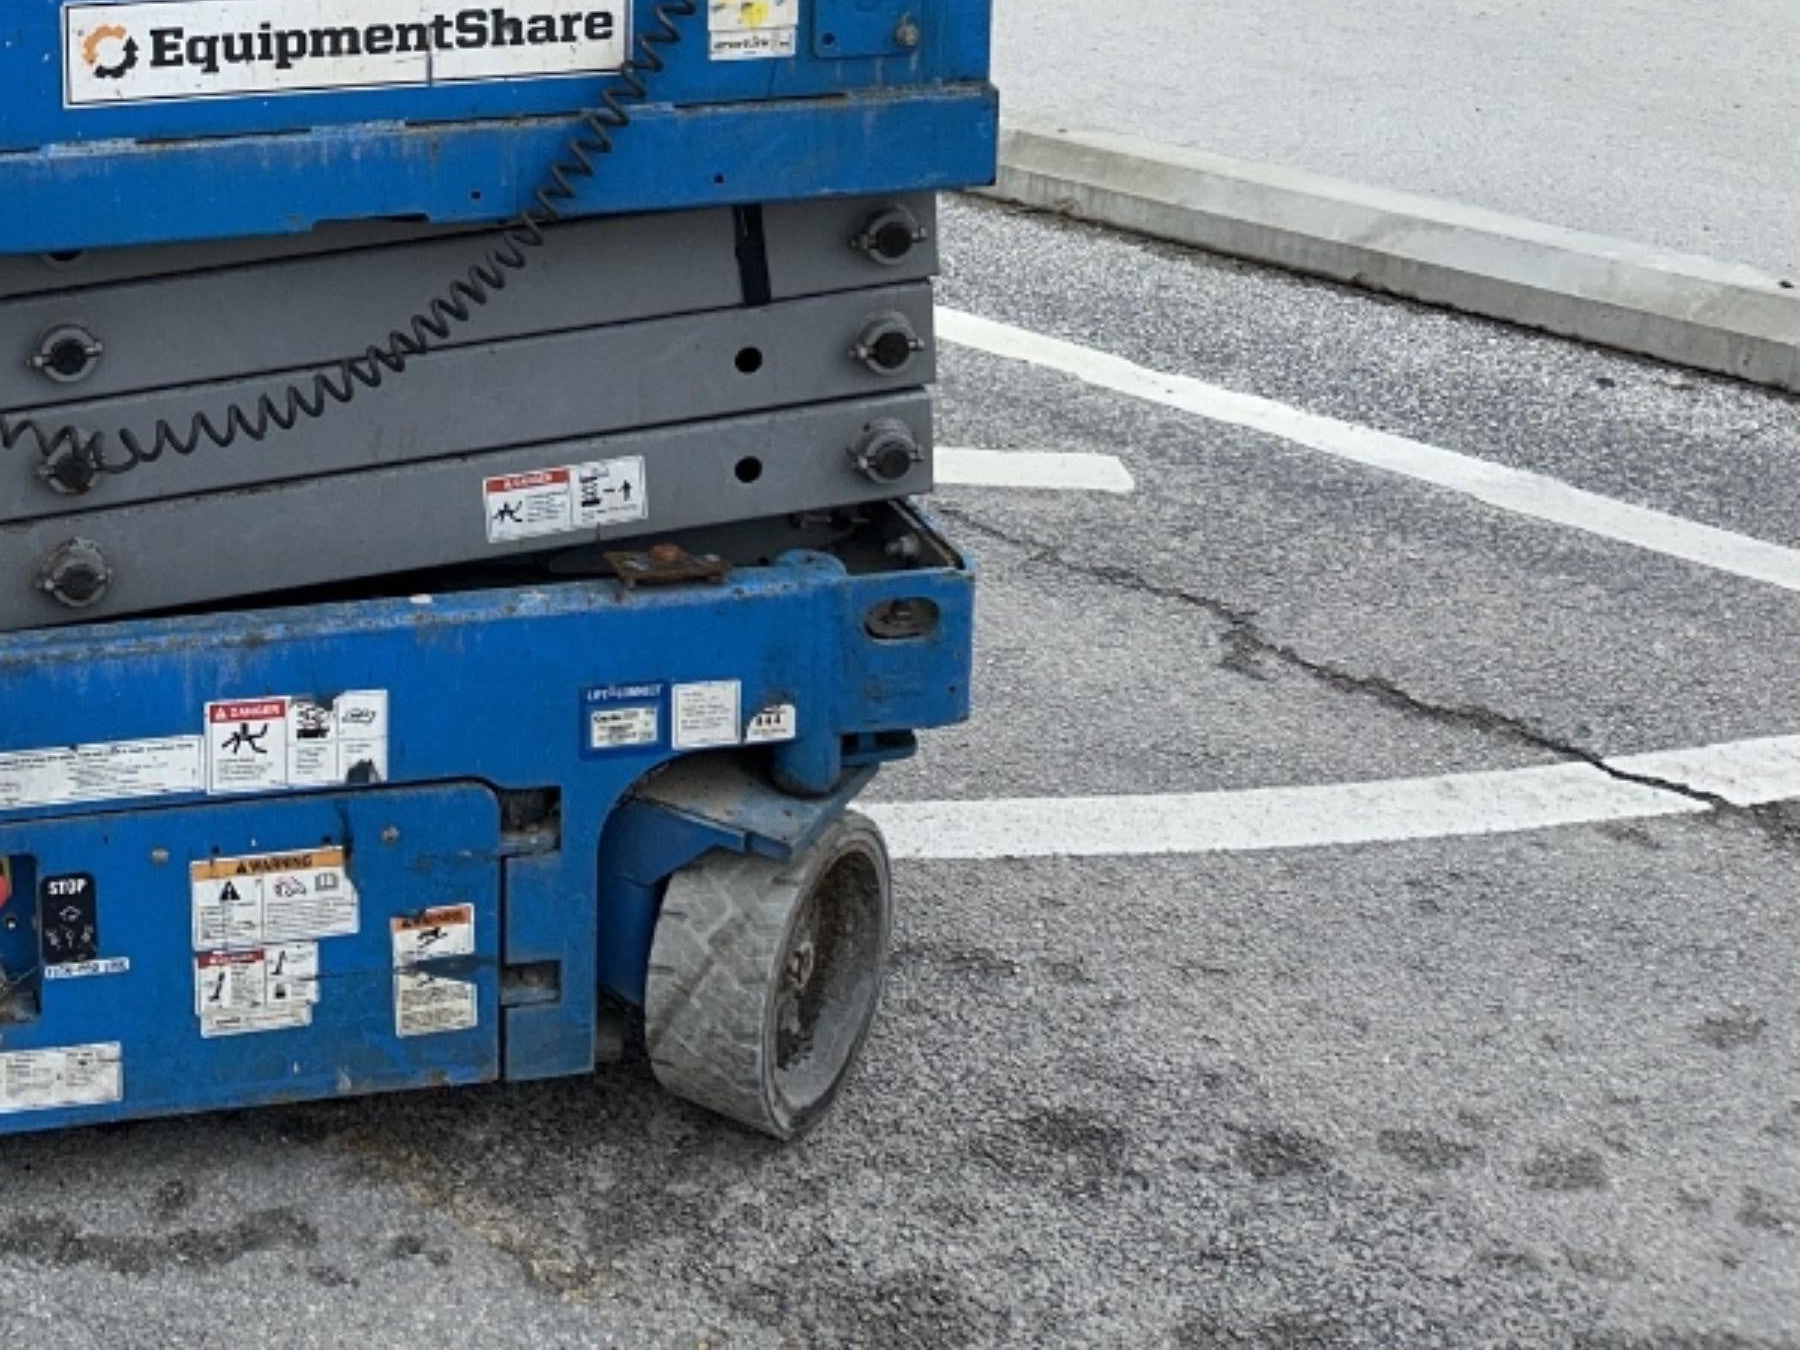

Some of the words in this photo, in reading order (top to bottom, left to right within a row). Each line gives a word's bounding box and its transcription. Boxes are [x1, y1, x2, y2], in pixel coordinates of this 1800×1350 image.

[150, 8, 613, 73] EquipmentShare
[248, 853, 313, 872] WARNING
[47, 878, 87, 895] STOP
